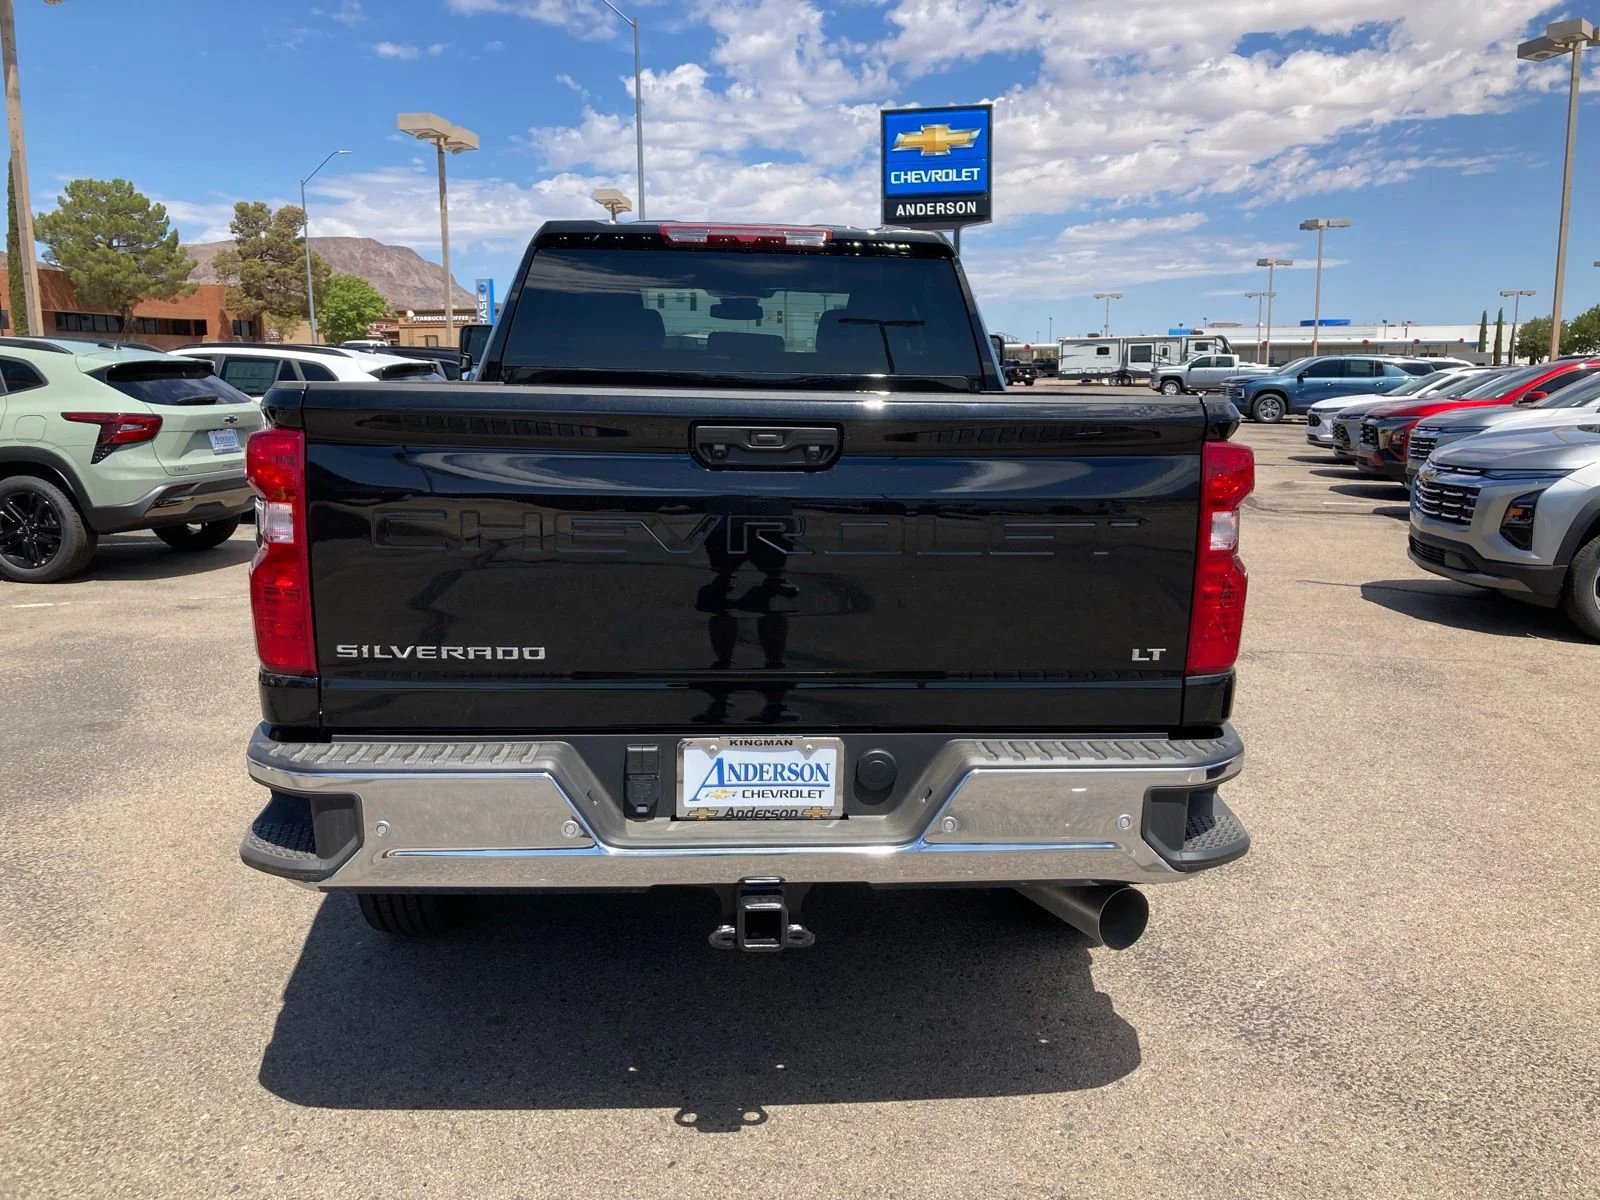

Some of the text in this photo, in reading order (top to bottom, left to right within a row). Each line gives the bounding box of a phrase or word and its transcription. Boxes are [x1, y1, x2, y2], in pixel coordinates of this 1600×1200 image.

[890, 168, 980, 184] CHEVROLET
[896, 201, 977, 216] ANDERSON
[479, 294, 487, 324] HASE
[371, 508, 1142, 556] CHEVROLET
[336, 644, 546, 660] SILVERADO
[1131, 648, 1167, 661] LT
[689, 757, 830, 801] ANDERSON
[742, 789, 825, 799] CHEVROLET
[723, 806, 799, 819] Anderson
